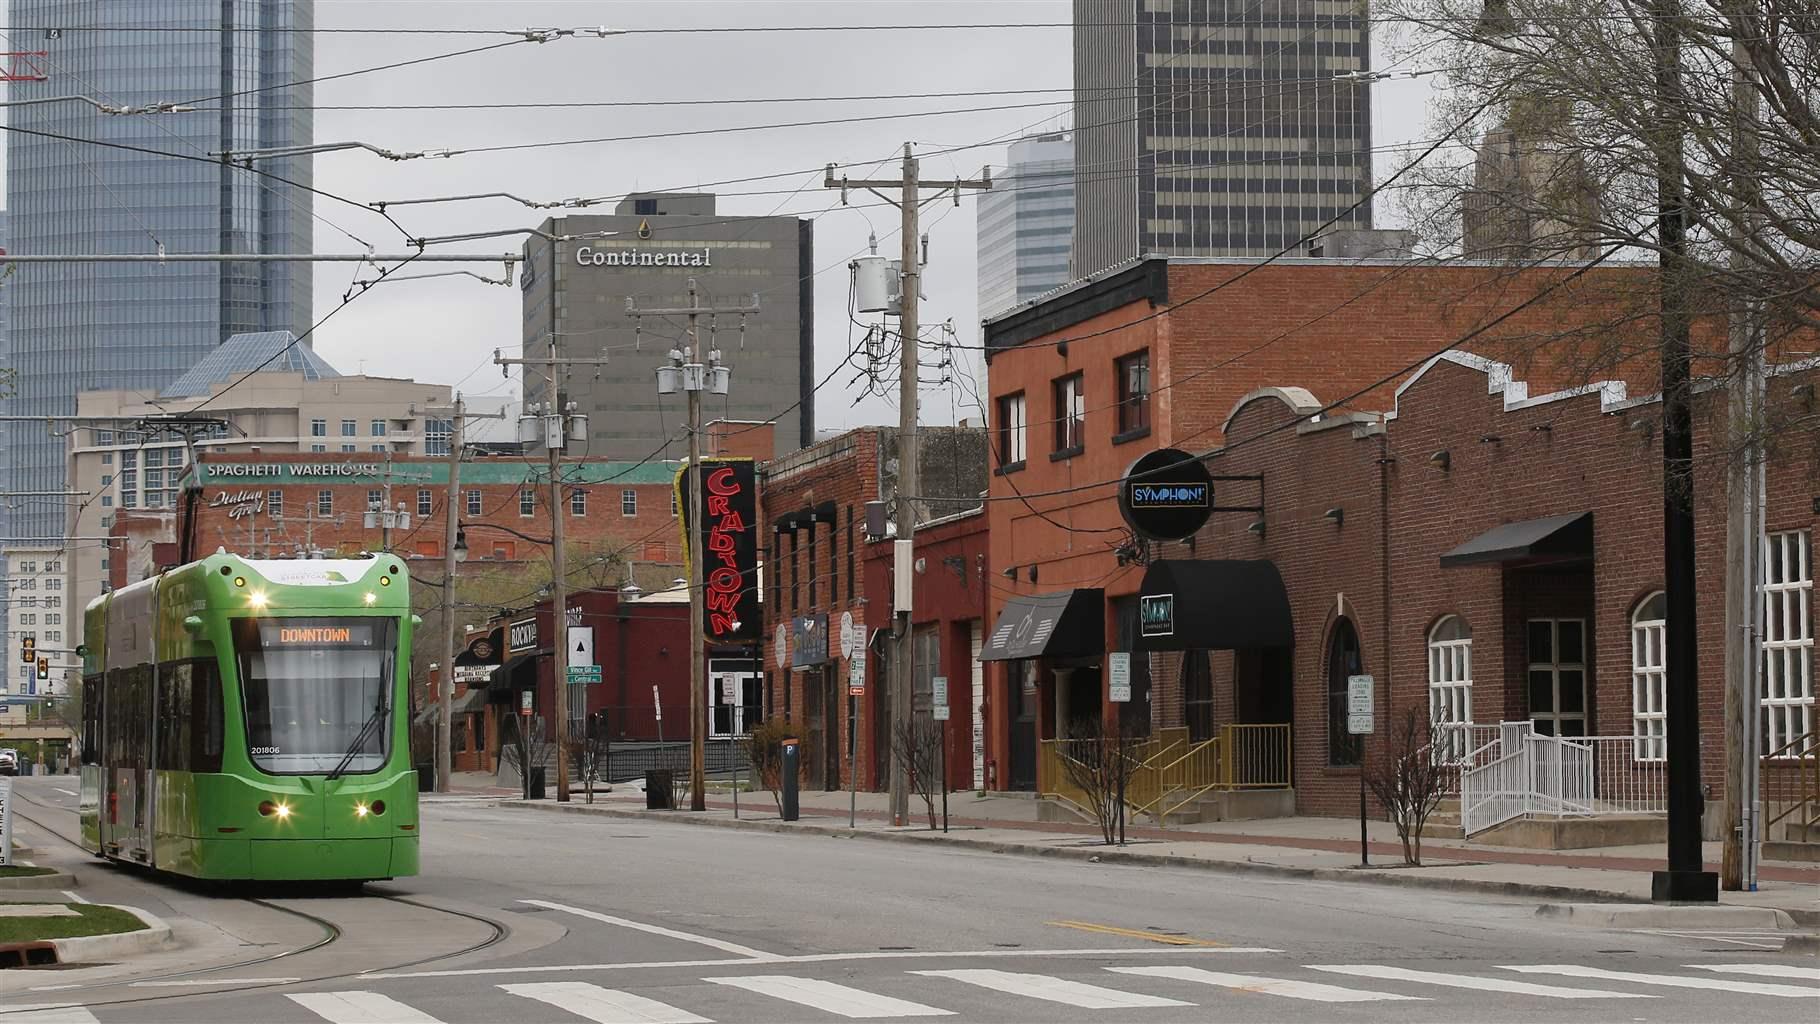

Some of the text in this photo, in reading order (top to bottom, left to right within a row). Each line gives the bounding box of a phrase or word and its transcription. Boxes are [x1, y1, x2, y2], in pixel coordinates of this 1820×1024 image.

[576, 246, 712, 267] Continental
[208, 464, 377, 476] SPAGHETTI WAREHOUSE
[209, 490, 262, 507] Italian
[229, 500, 264, 520] Gril
[281, 628, 350, 643] DOWNTOWN
[251, 746, 280, 754] 201806
[786, 745, 793, 754] P
